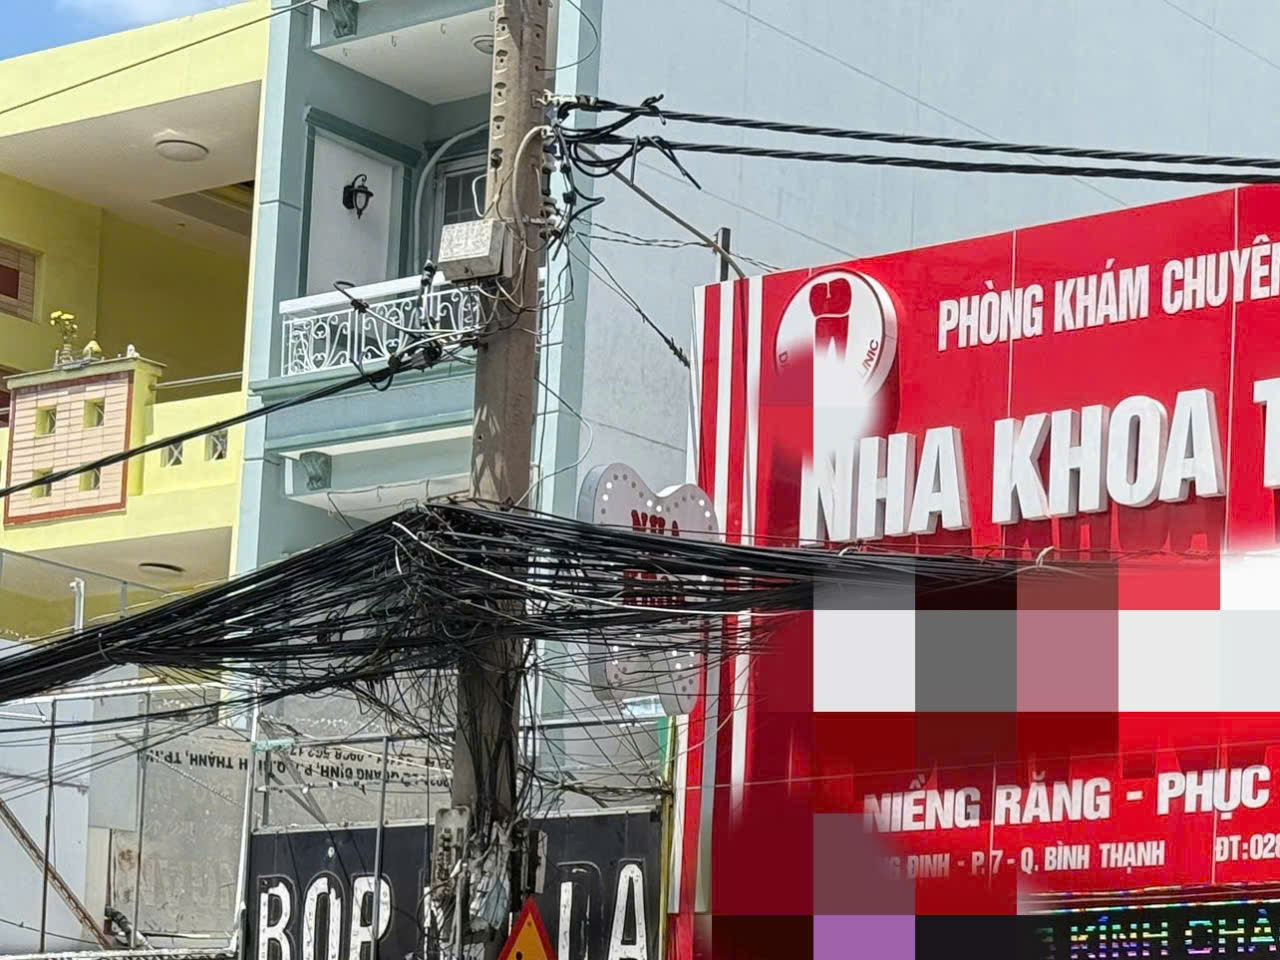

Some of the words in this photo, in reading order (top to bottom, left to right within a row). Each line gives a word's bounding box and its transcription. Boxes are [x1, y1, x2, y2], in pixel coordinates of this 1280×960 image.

[937, 280, 1042, 351] PHÒNG
[1053, 258, 1149, 332] KHÁM
[800, 426, 971, 547] NHA
[992, 388, 1226, 526] KHOA
[995, 769, 1111, 826] RĂNG
[1157, 764, 1270, 820] PHỤC
[1020, 847, 1039, 873] Q.
[1044, 840, 1090, 872] BÌNH
[1099, 840, 1165, 875] THẠNH
